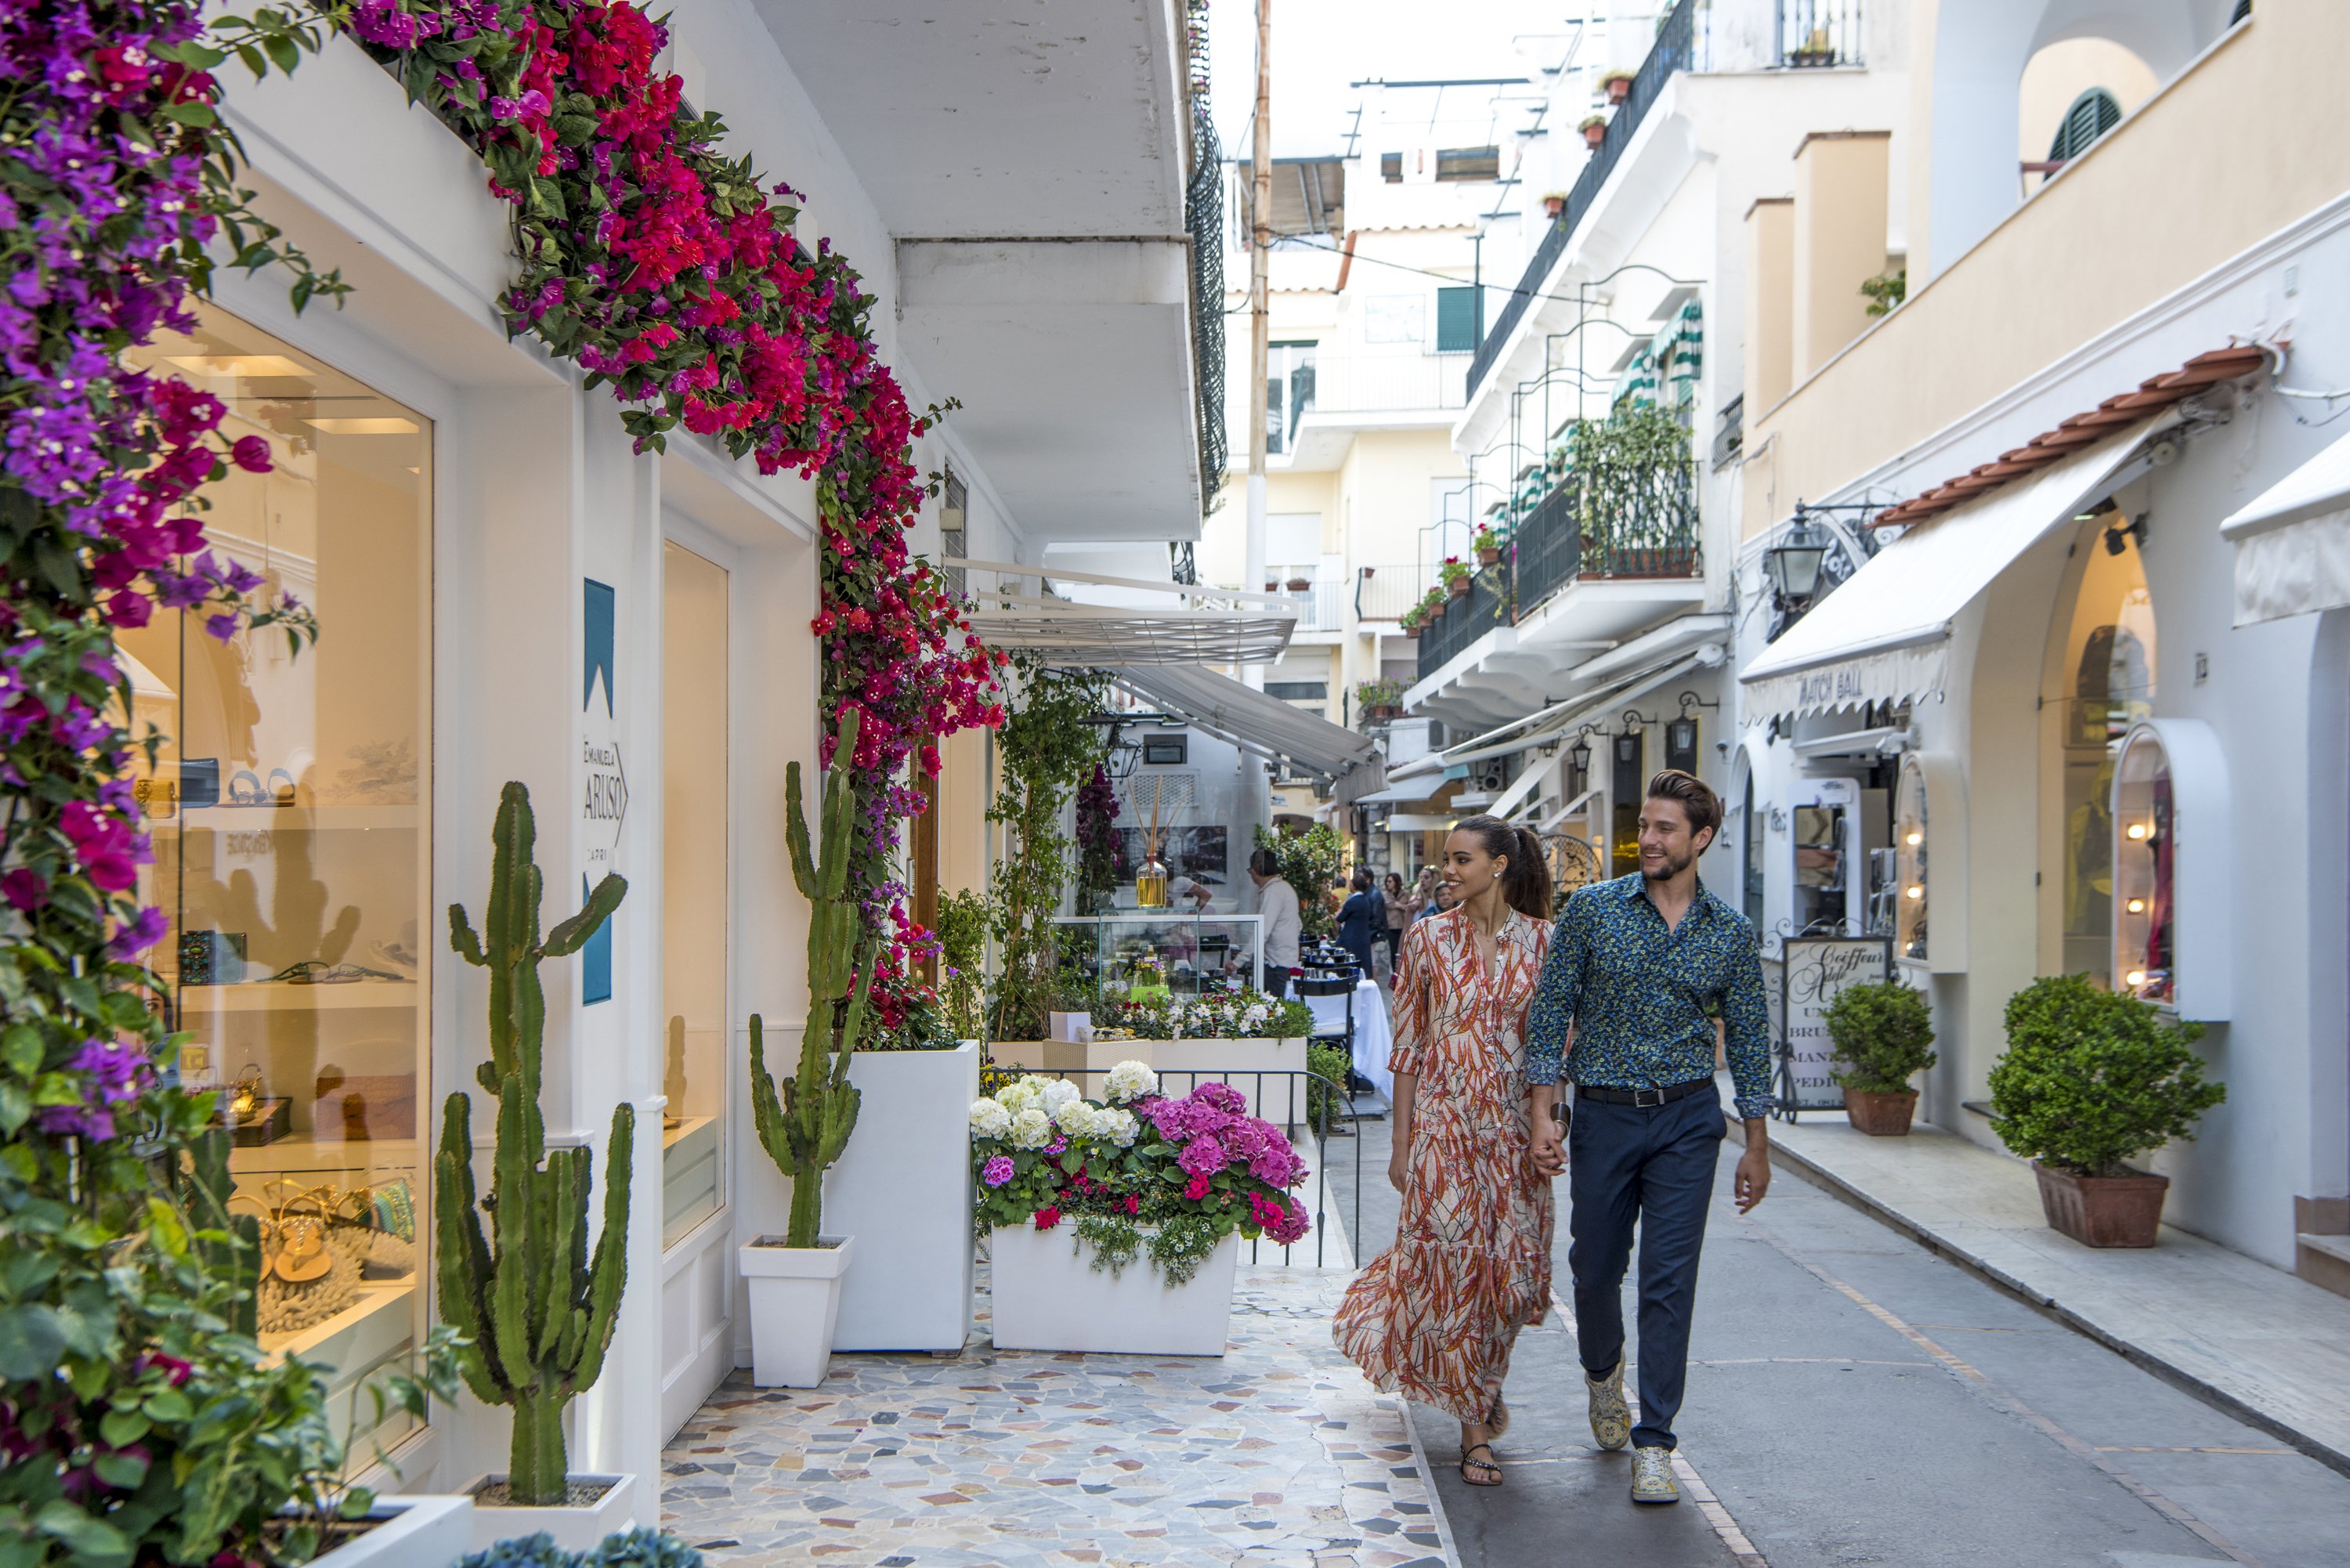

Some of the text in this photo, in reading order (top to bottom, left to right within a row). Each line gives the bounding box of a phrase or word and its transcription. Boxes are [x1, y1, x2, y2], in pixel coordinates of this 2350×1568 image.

[1799, 668, 1863, 706] MATCH BALL
[1809, 943, 1883, 970] Coiffeur
